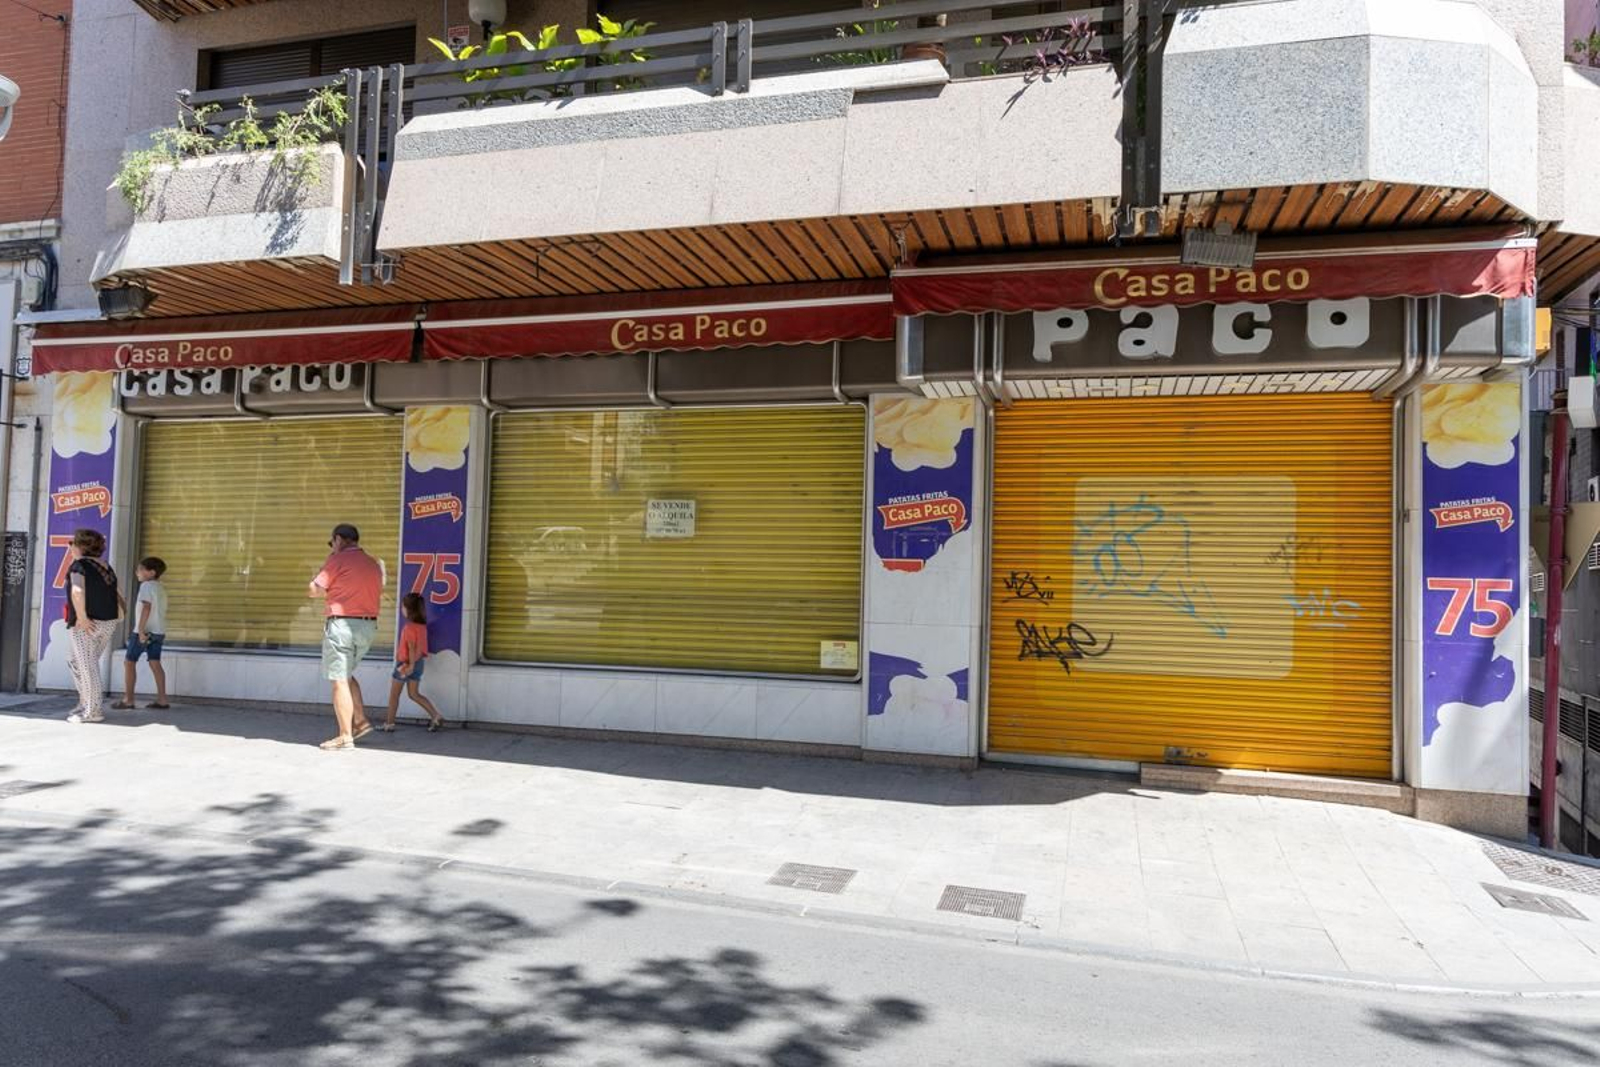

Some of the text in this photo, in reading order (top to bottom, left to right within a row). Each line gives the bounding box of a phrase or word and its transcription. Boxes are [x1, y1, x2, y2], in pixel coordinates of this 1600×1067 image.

[1094, 267, 1310, 306] Casa Paco
[611, 315, 768, 350] Casa Paco
[114, 341, 233, 369] Casa Paco
[58, 491, 106, 507] Casa Paco
[888, 490, 949, 504] PATATAS FRITAS
[1440, 497, 1496, 508] PATATAS FRITAS
[415, 500, 458, 514] Casa Paco
[888, 503, 958, 521] Casa Paco
[1440, 506, 1505, 522] Casa Paco
[404, 552, 461, 605] 75
[1427, 577, 1514, 638] 75
